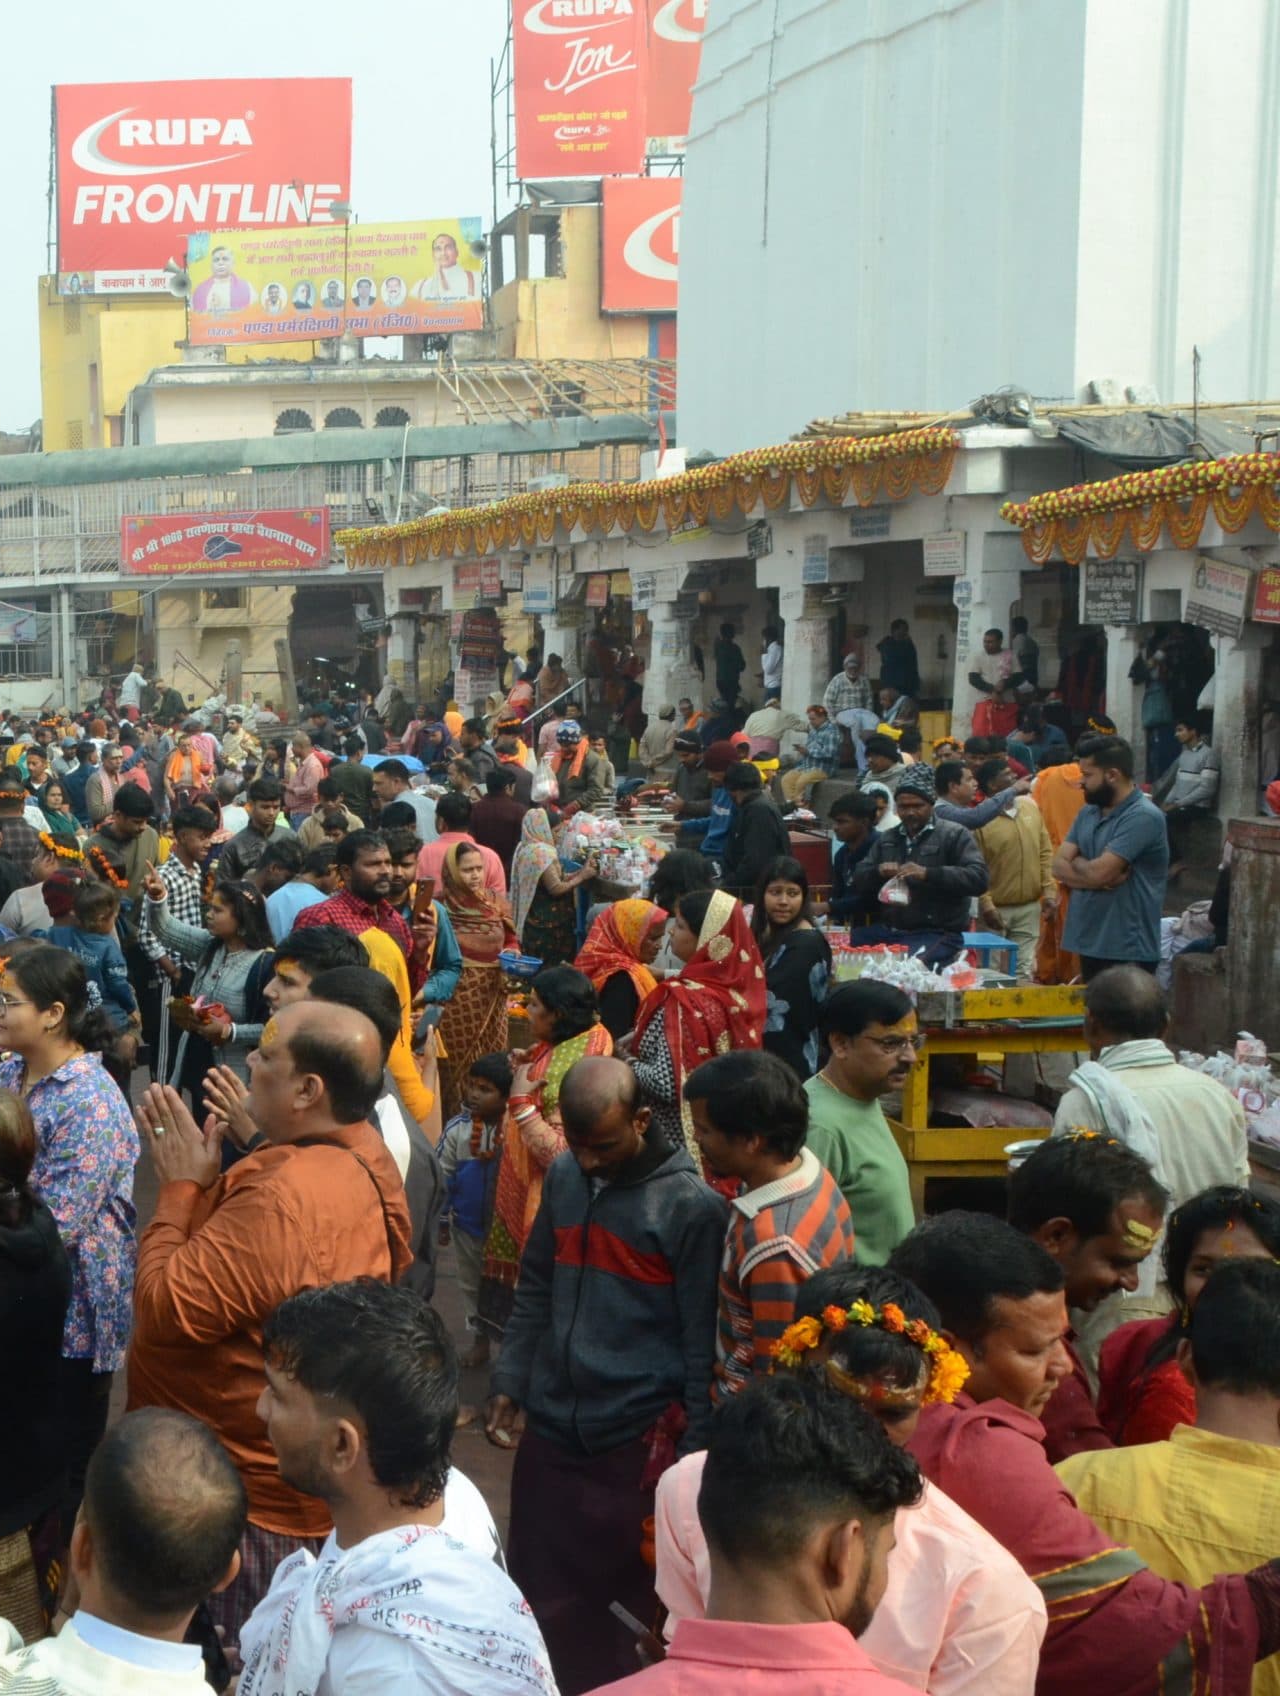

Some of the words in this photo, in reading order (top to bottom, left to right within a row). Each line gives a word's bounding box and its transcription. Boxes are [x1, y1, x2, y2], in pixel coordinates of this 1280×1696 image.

[552, 0, 633, 16] RUPA
[544, 37, 632, 91] Jon
[119, 118, 252, 147] RUPA
[73, 184, 341, 225] FRONTLINE
